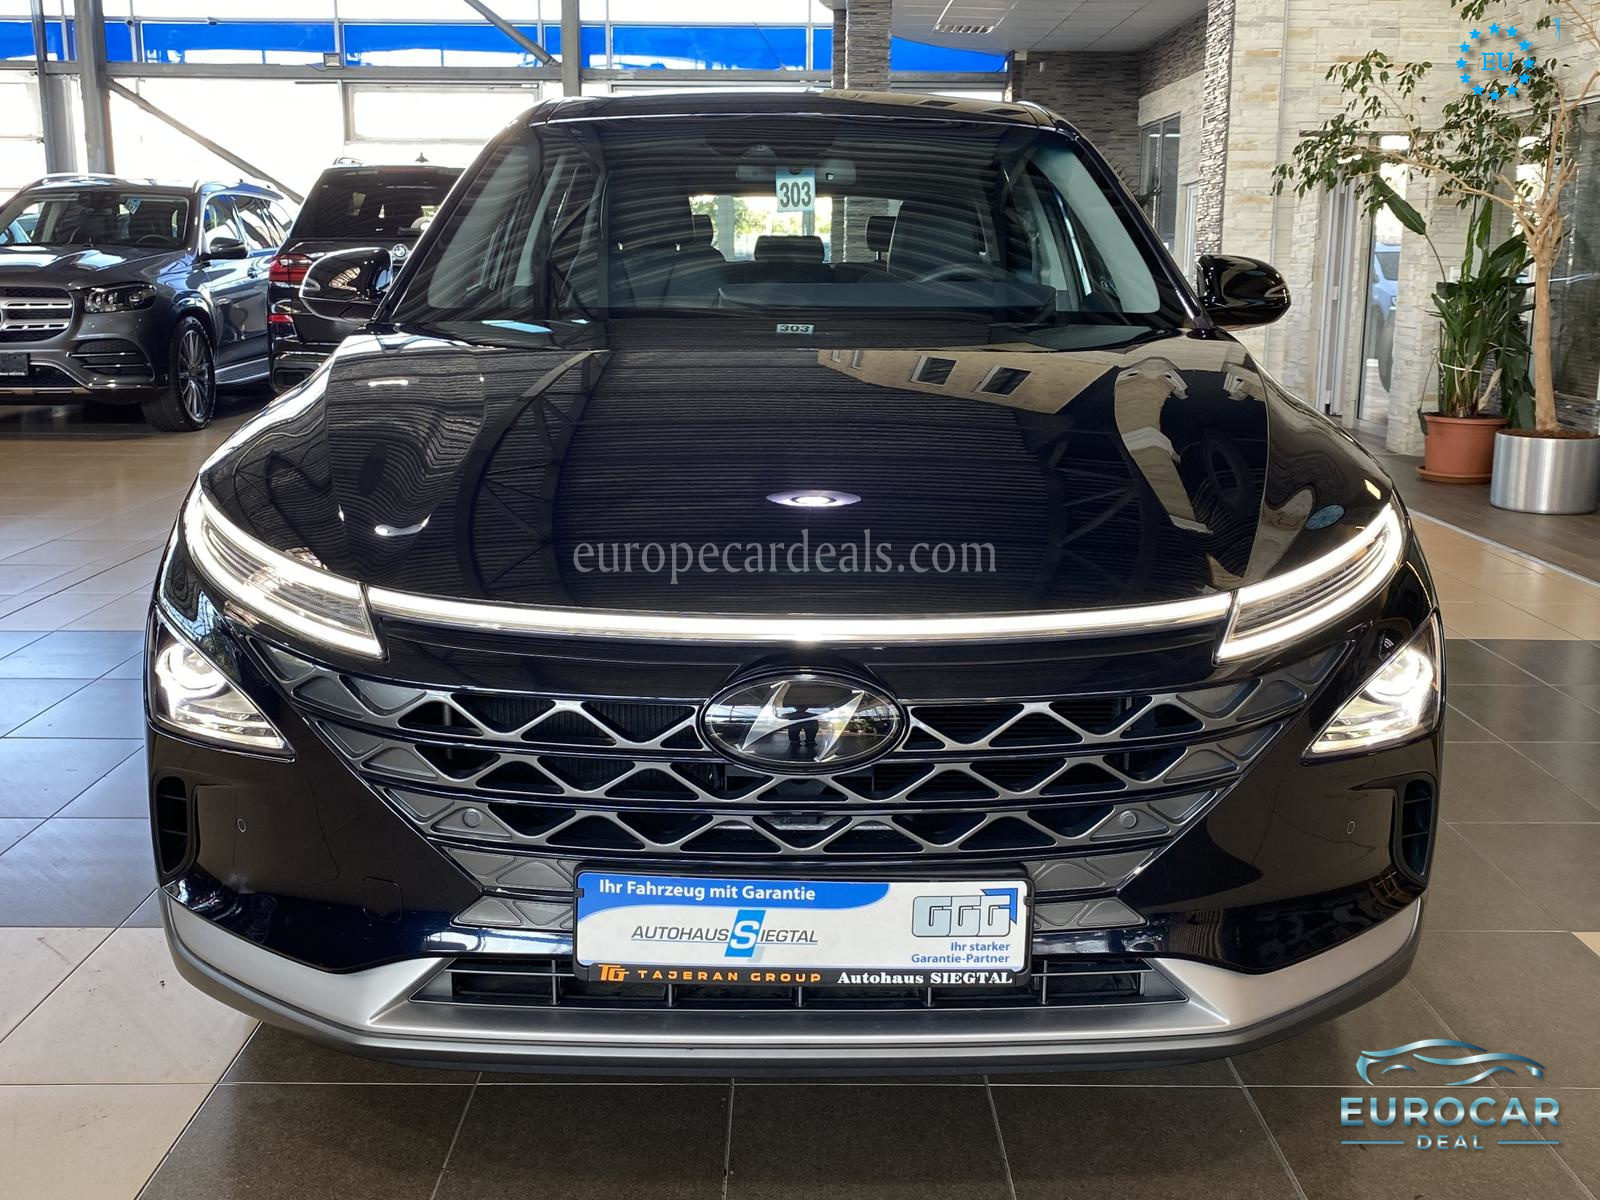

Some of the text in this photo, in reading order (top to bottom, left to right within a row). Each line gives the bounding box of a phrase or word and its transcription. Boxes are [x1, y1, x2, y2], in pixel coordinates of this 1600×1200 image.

[779, 181, 812, 208] 303
[599, 879, 816, 901] Ihr Fahrzeug mit Garantie
[631, 919, 819, 950] AUTOHAUS SIEGTAL
[950, 941, 1010, 952] Ihr starker
[911, 953, 1010, 964] Garantie-Partner
[637, 970, 739, 982] TAJERAN
[750, 972, 821, 983] GROUP
[837, 971, 1013, 984] Autohaus SIEGTAL
